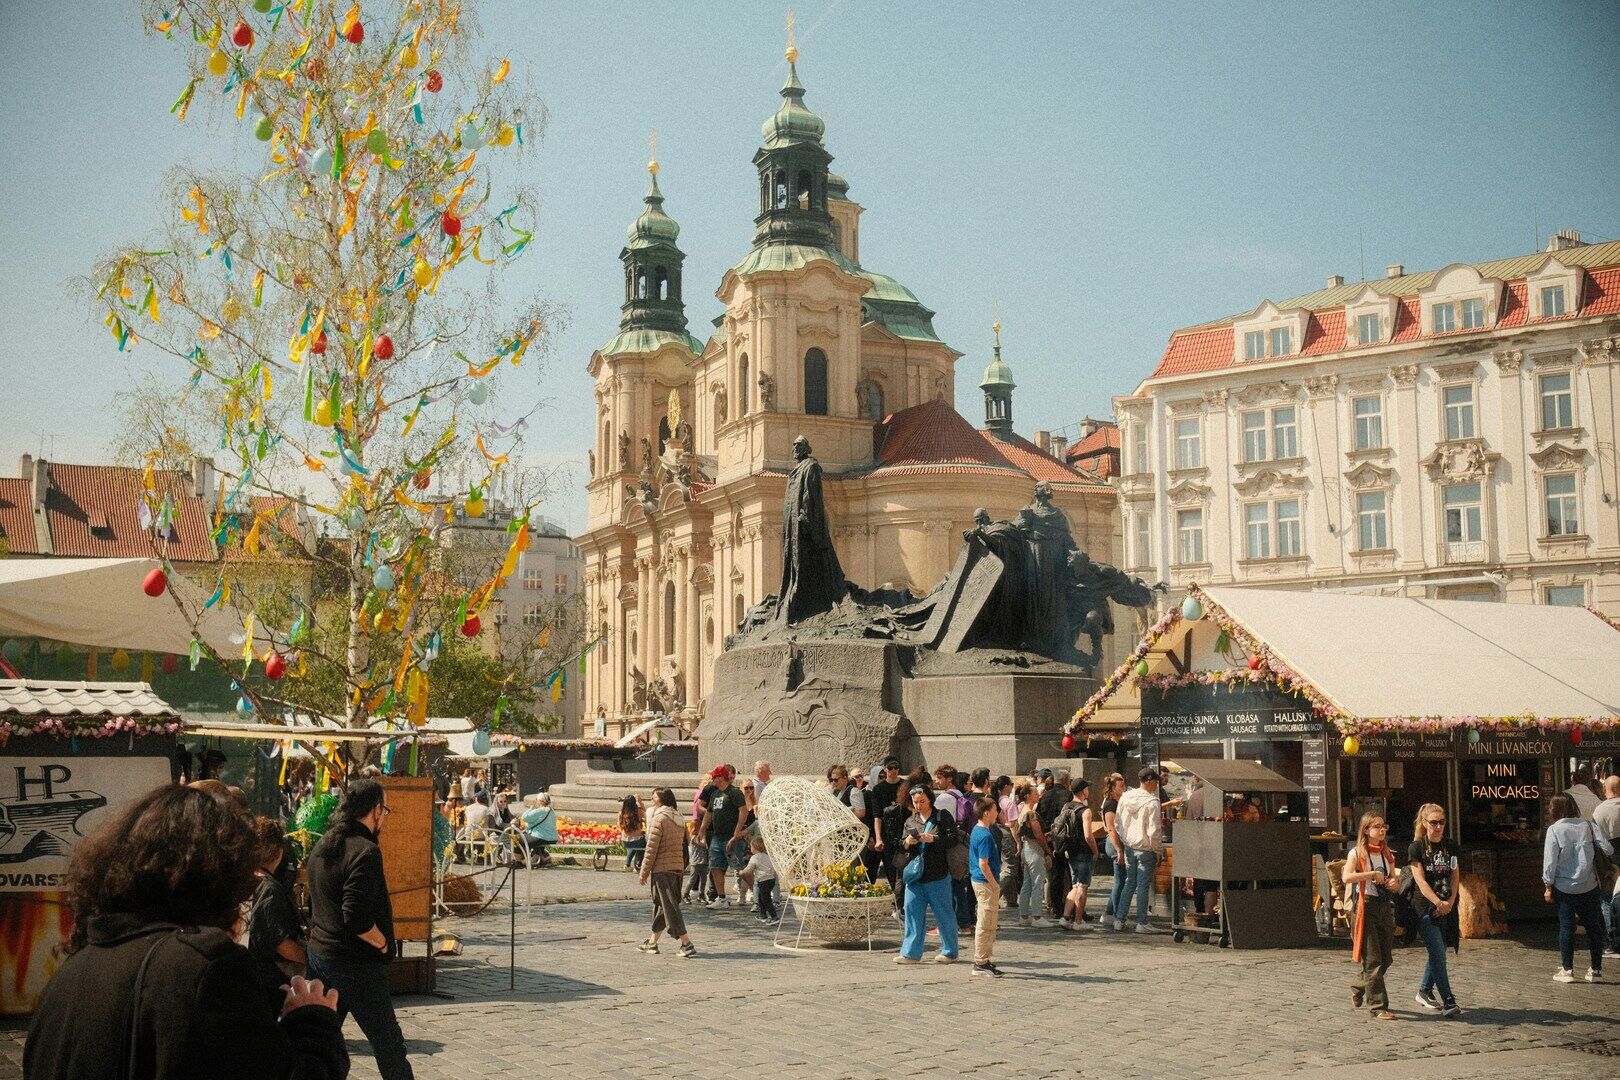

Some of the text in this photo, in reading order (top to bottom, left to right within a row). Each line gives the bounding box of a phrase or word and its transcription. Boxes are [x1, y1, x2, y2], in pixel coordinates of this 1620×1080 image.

[1141, 709, 1313, 726] STAROPRAŽSKÁ ŠUNKA KLOBÁSA HALUŠKY
[1154, 727, 1166, 735] OLD
[1167, 726, 1189, 735] PRAGUE
[1190, 726, 1206, 735] HAM
[1229, 725, 1257, 734] SAUSAGE
[1468, 742, 1492, 755] MINI
[1496, 739, 1554, 755] LÍVANEČKY
[1487, 763, 1516, 777] MINI
[13, 764, 72, 802] HP
[1471, 785, 1540, 799] PANCAKES
